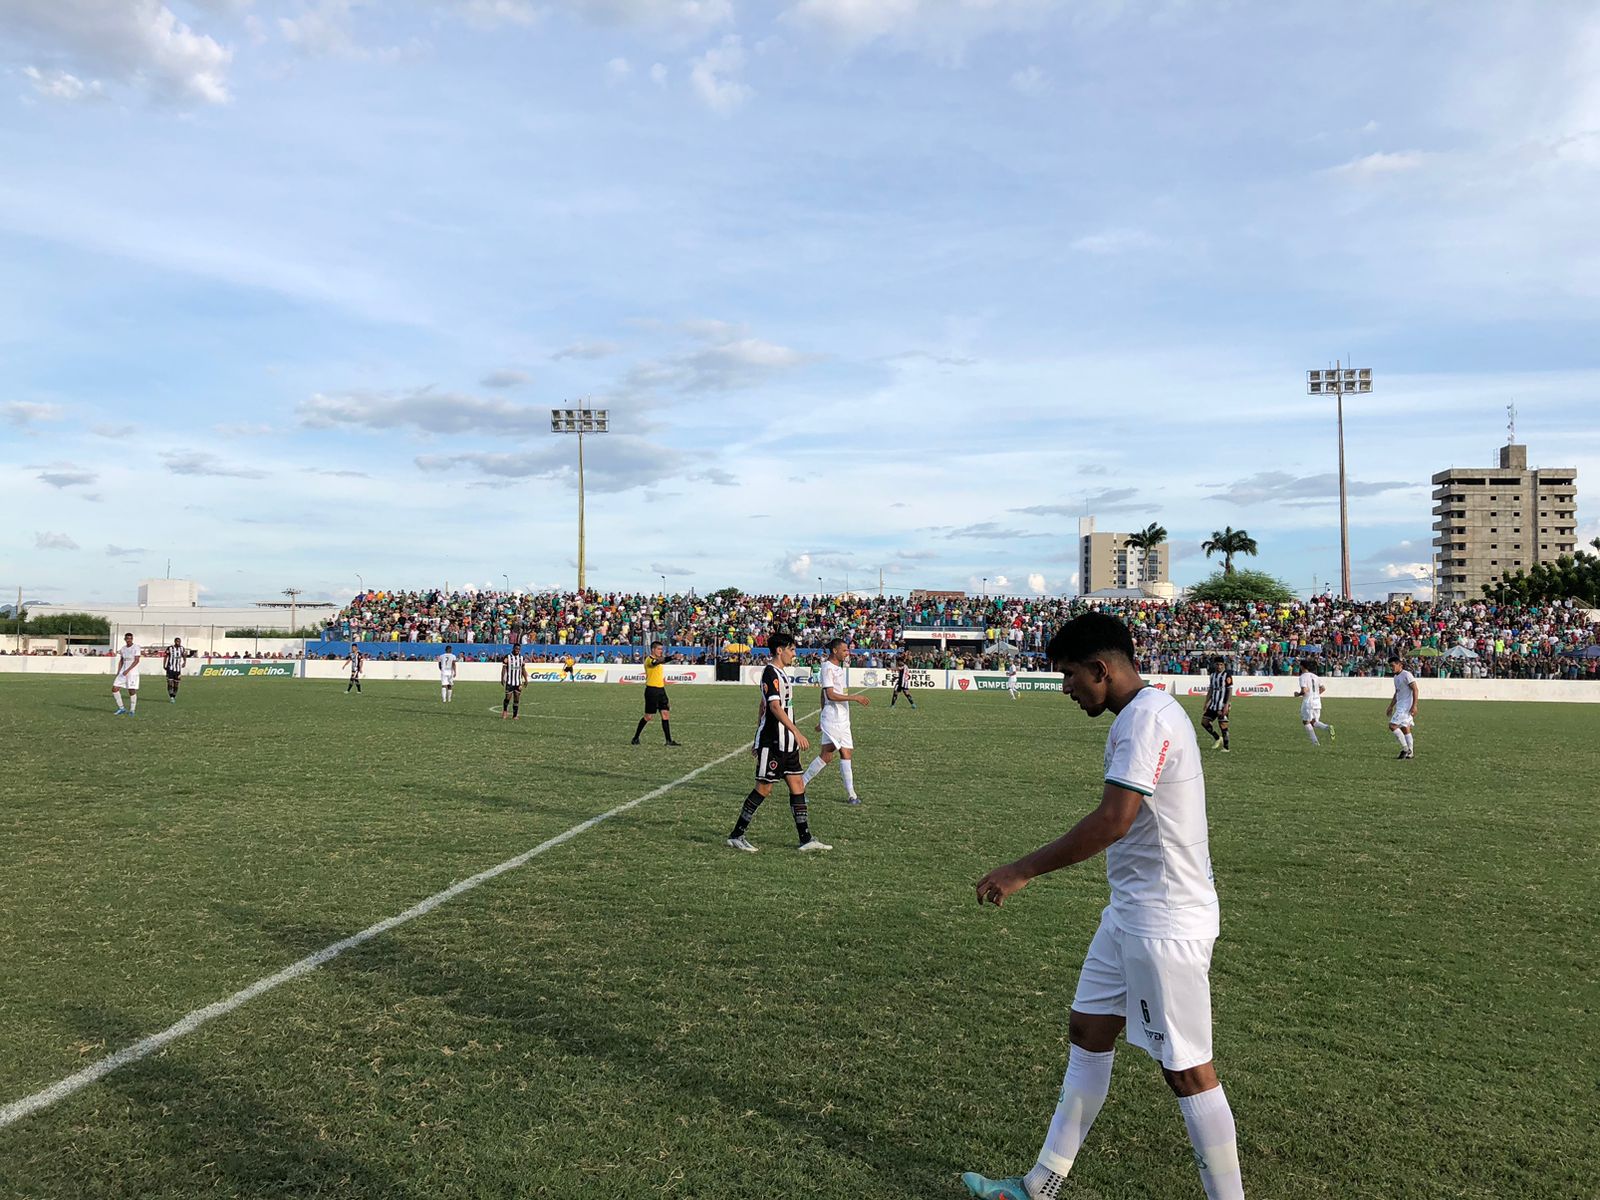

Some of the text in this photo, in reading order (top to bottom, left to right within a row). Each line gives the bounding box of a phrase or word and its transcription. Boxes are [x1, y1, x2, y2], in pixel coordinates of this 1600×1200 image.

[885, 673, 931, 681] ESORTE
[978, 681, 1031, 690] CAMPEATO
[1140, 999, 1151, 1023] 6
